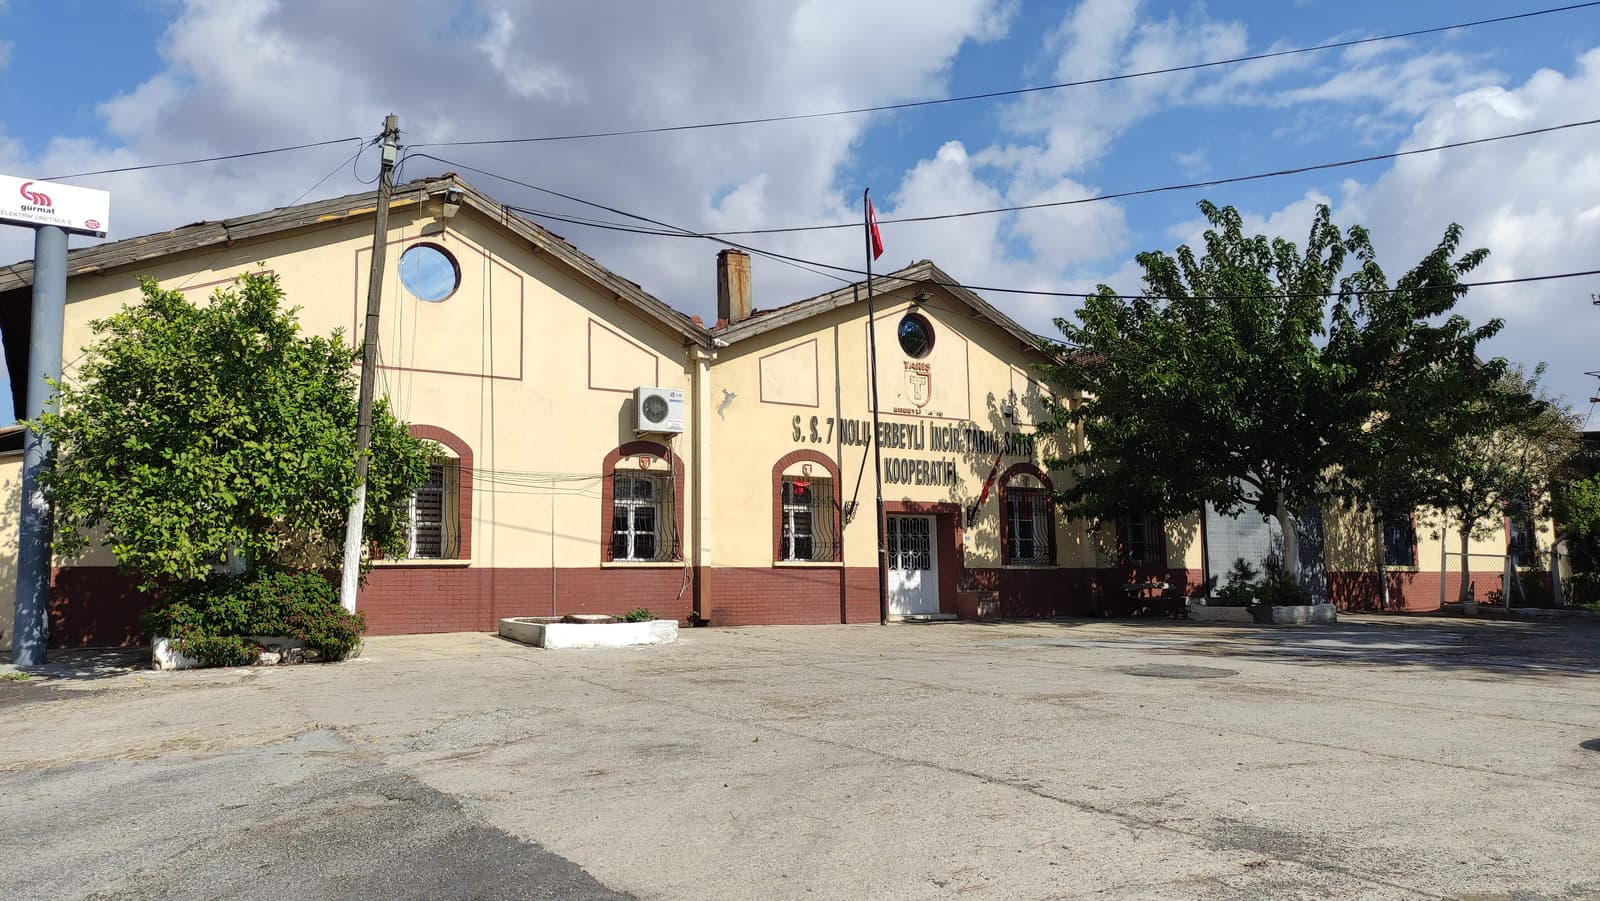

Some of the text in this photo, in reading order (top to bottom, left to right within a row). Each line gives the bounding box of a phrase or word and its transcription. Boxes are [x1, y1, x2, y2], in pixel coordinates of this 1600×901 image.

[20, 204, 55, 215] gürmat
[826, 417, 835, 445] 7
[840, 417, 871, 447] NOLU
[878, 419, 925, 450] ERBEYLİ
[884, 456, 957, 487] KOOPERATİFİ
